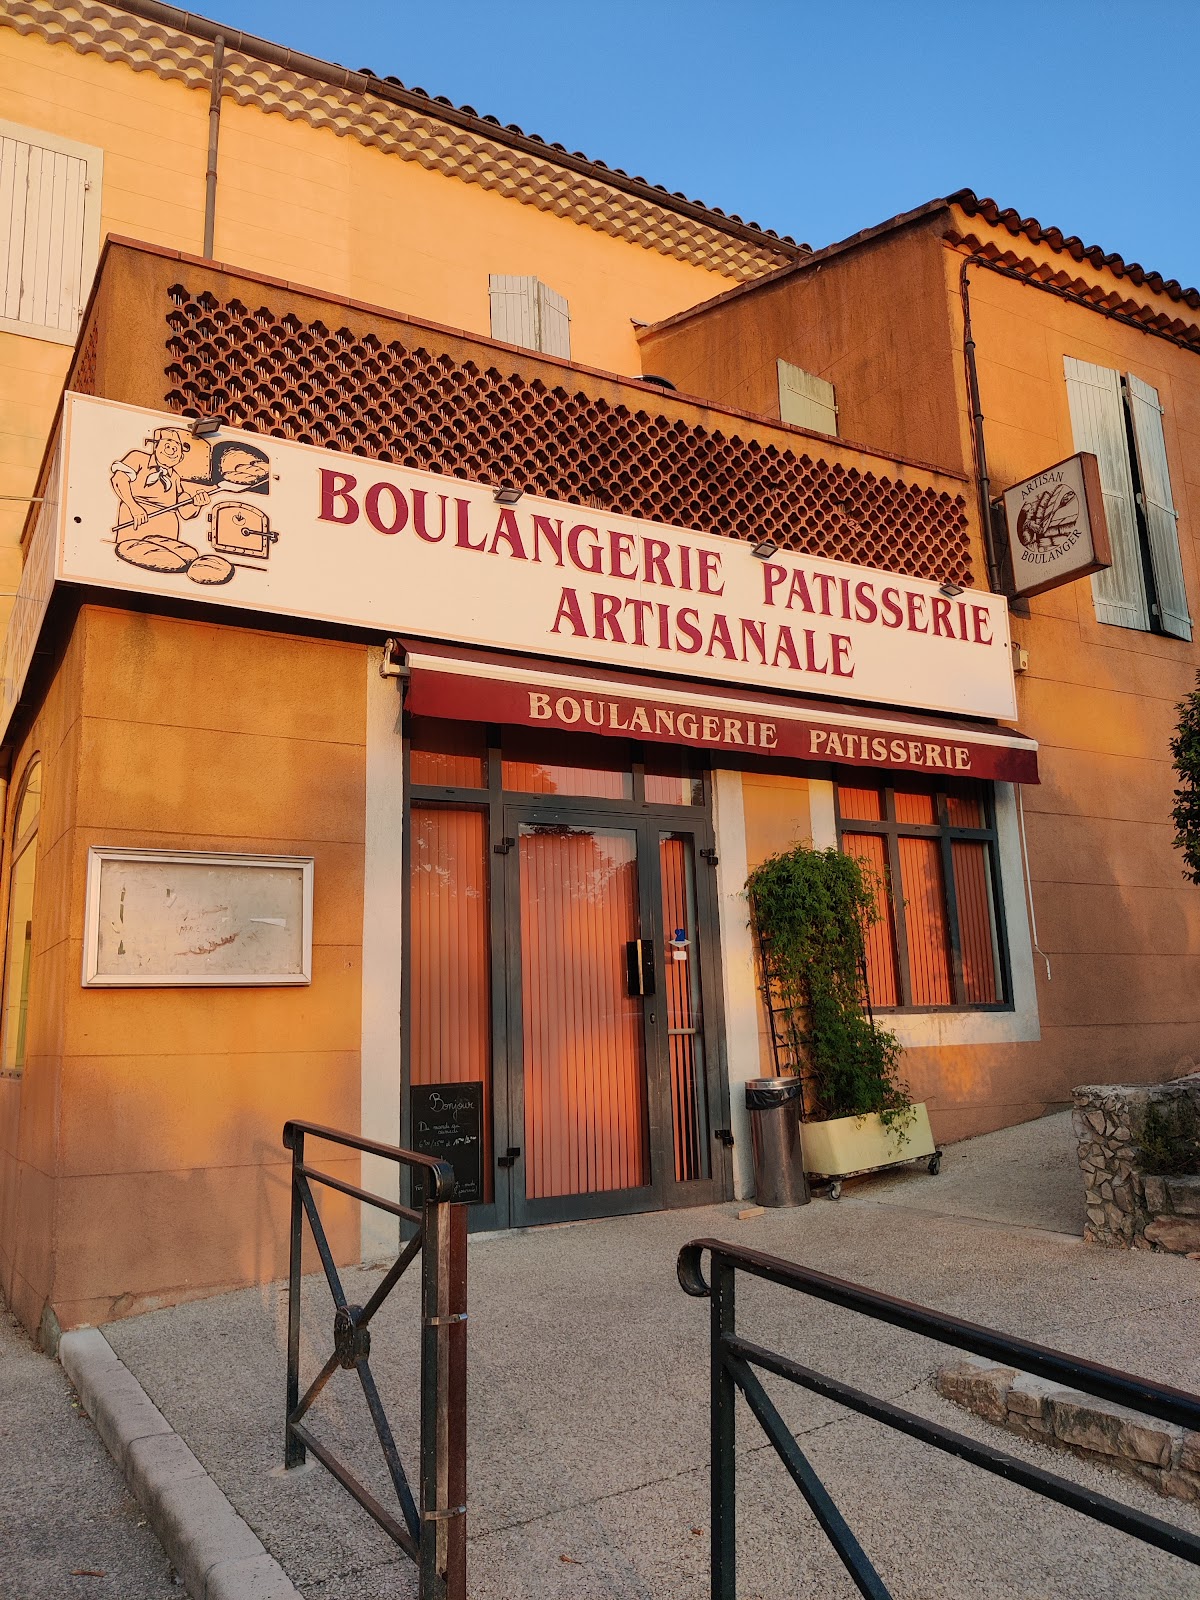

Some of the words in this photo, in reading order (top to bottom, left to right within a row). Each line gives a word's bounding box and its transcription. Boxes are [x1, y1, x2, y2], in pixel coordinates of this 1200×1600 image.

[1020, 471, 1064, 500] ARTISAN
[316, 467, 726, 597] BOULANGERIE
[761, 561, 994, 646] PATISSERIE
[1020, 528, 1082, 565] BOULANGER
[550, 586, 855, 678] ARTISANALE
[528, 691, 779, 749] BOULANGERIE
[809, 728, 972, 771] PATISSERIE
[429, 1092, 475, 1122] Bonjour
